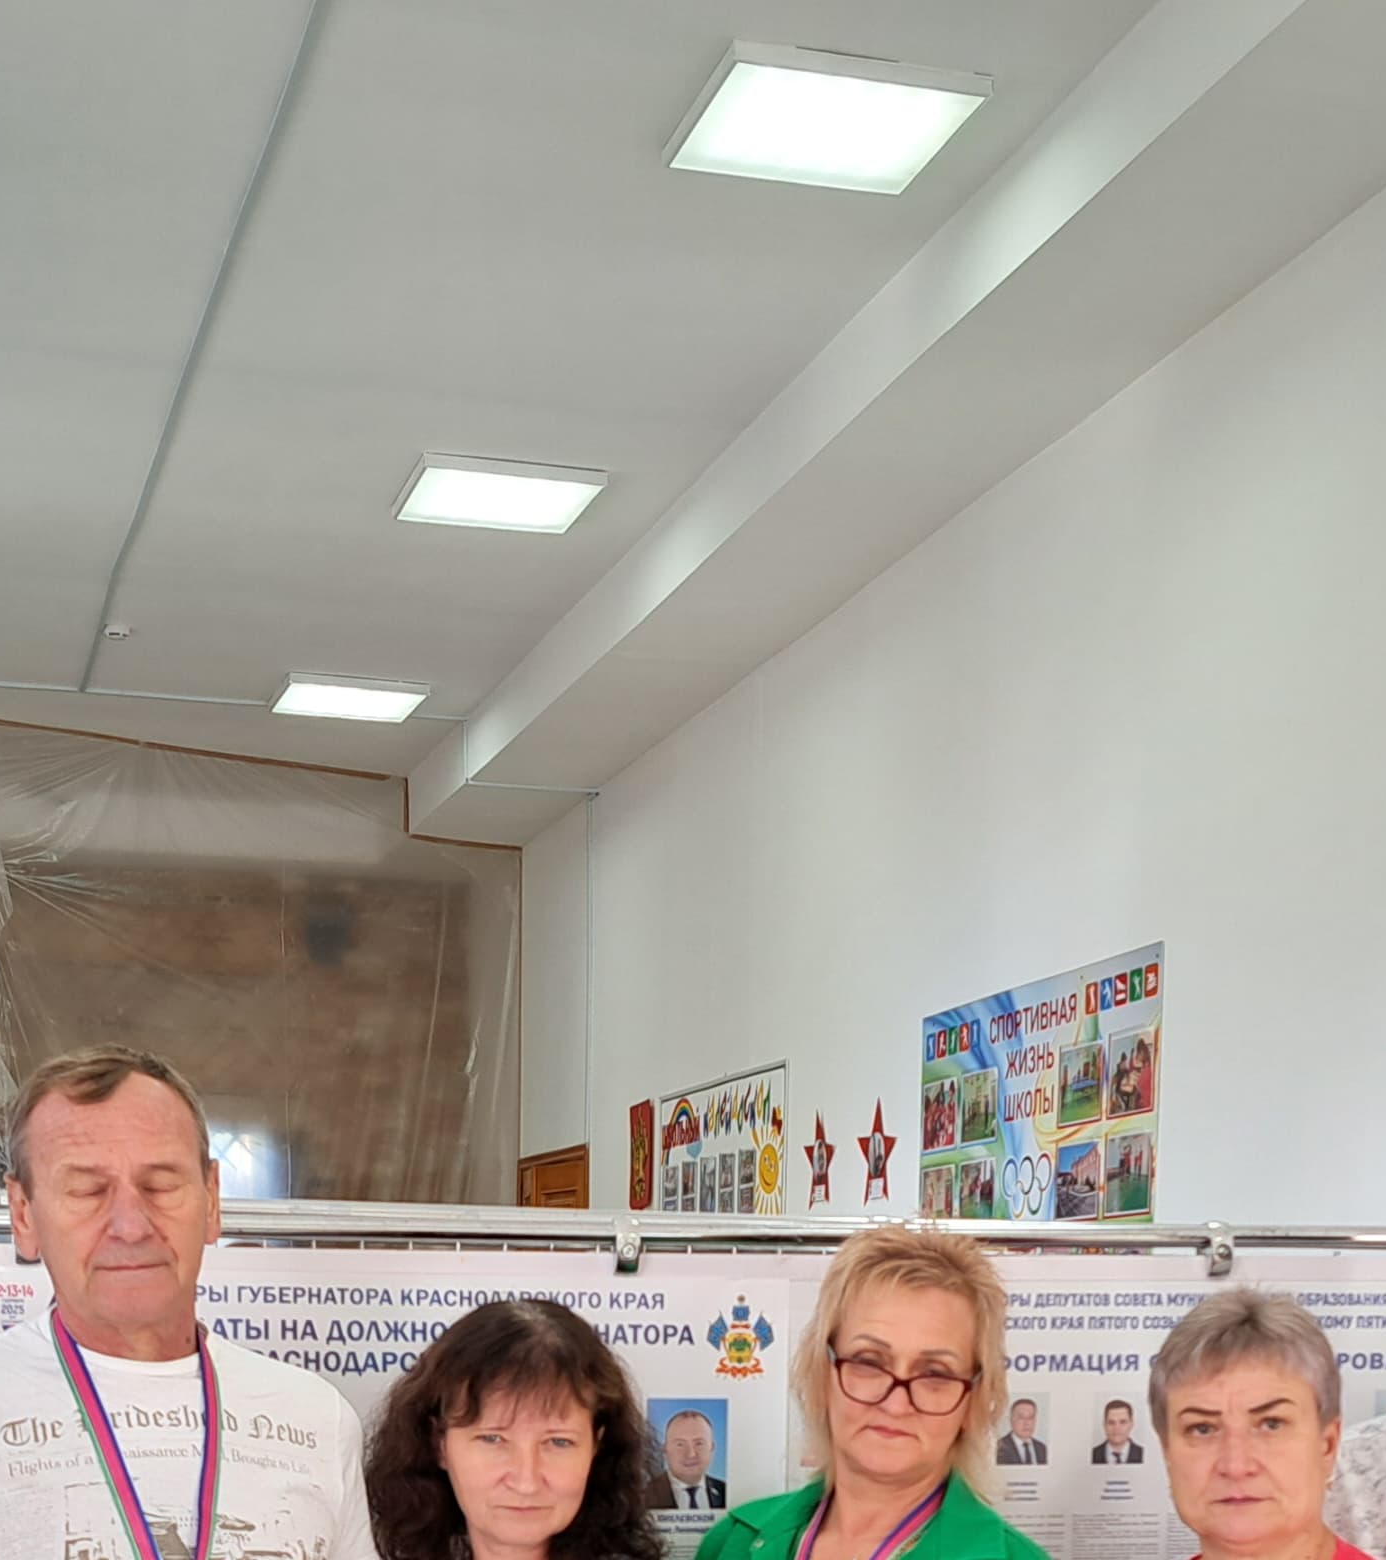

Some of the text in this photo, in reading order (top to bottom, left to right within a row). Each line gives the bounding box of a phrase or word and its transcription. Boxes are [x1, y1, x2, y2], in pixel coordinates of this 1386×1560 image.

[989, 992, 1078, 1044] СПОРТИВНАЯ
[1005, 1041, 1055, 1080] ЖИЗНЬ
[1004, 1084, 1055, 1122] ШКОЛЫ
[237, 1286, 394, 1307] ГУБЕРНАТОРА
[609, 1291, 666, 1310] КРАЯ
[1034, 1293, 1110, 1309] ДЕПУТАТОВ
[1114, 1293, 1163, 1307] СОВЕТА
[281, 1319, 318, 1342] НА
[326, 1320, 447, 1346] ДОЛЖНО
[593, 1323, 695, 1346] НАТОРА
[1051, 1316, 1085, 1331] КРАЯ
[1087, 1316, 1140, 1331] ПЯТОГО
[1143, 1316, 1182, 1330] СОЗЫ
[0, 1417, 63, 1447] The
[248, 1414, 318, 1450] News
